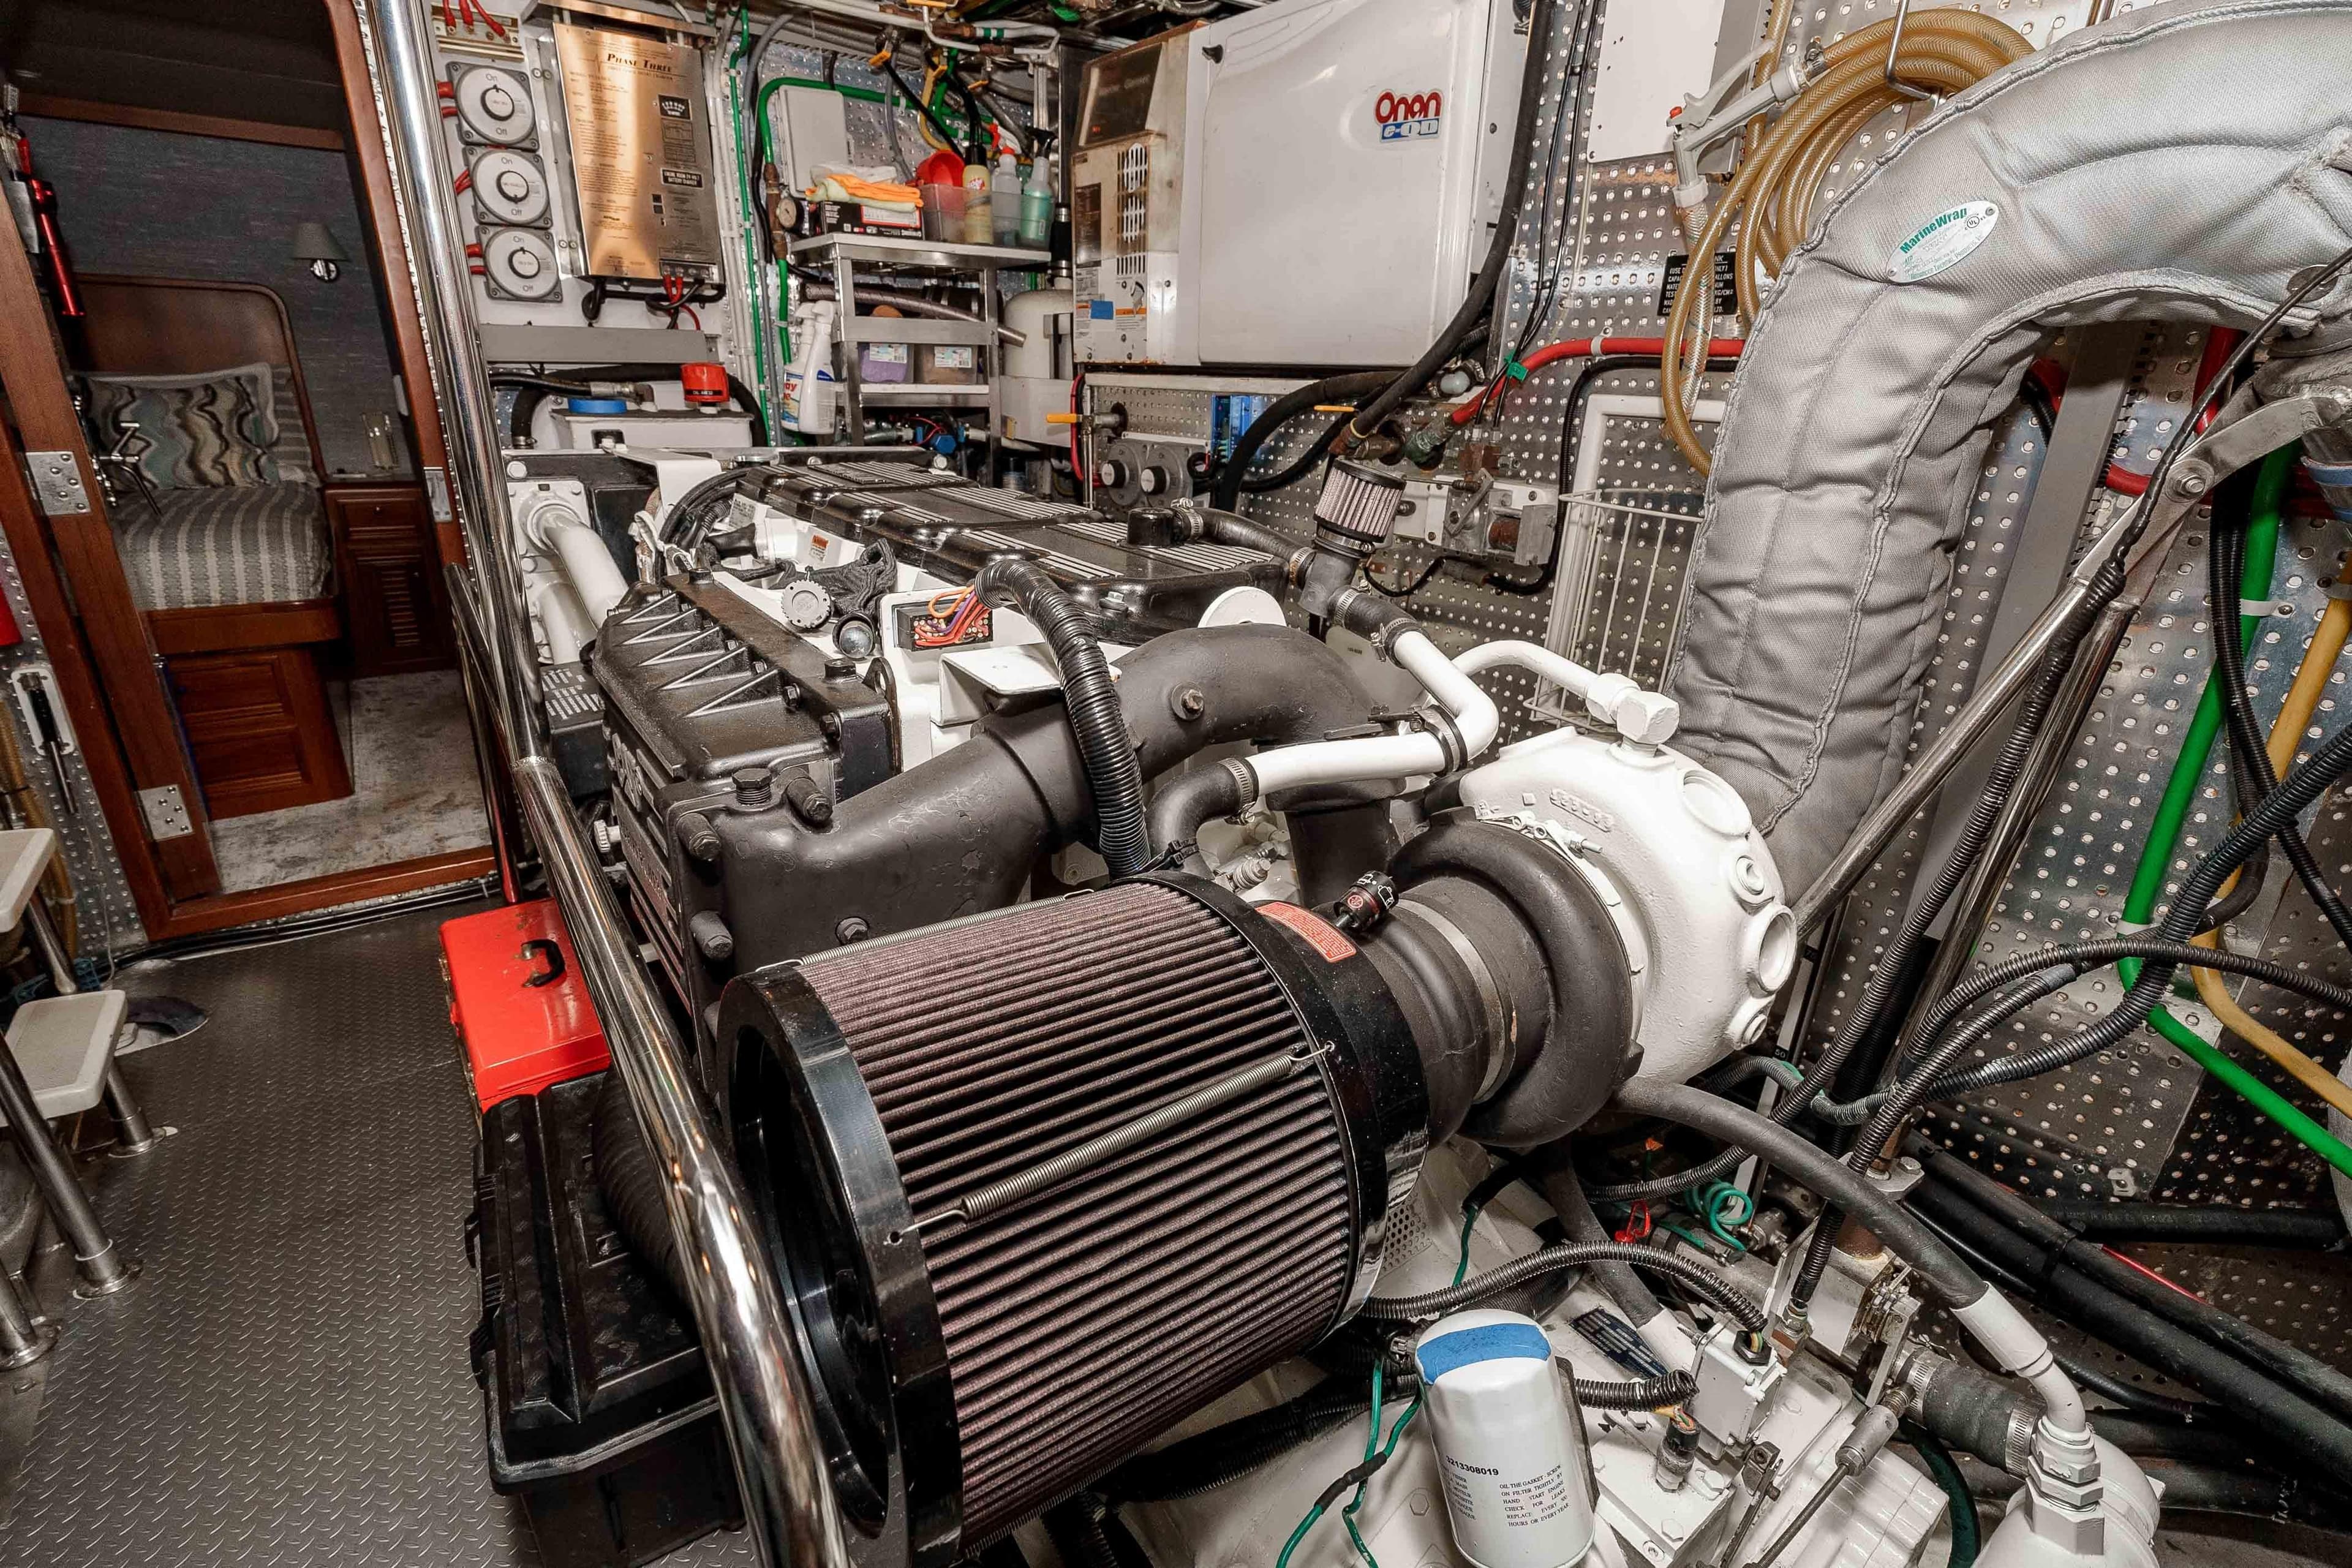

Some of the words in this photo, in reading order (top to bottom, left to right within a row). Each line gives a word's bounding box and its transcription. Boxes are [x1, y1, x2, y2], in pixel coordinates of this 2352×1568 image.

[485, 74, 497, 82] On
[1376, 92, 1442, 124] Onan
[496, 127, 507, 135] Off
[511, 208, 522, 216] Off
[1899, 208, 1967, 254] MarineWrap
[522, 284, 533, 293] Off
[1523, 1475, 1544, 1487] GASKET
[1547, 1464, 1561, 1477] SCREW
[1512, 1488, 1532, 1496] FILTER
[1534, 1478, 1555, 1491] TIGHTLY
[1551, 1487, 1566, 1501] LEAKS
[1541, 1501, 1557, 1513] EVERY
[1541, 1510, 1557, 1521] EVERY
